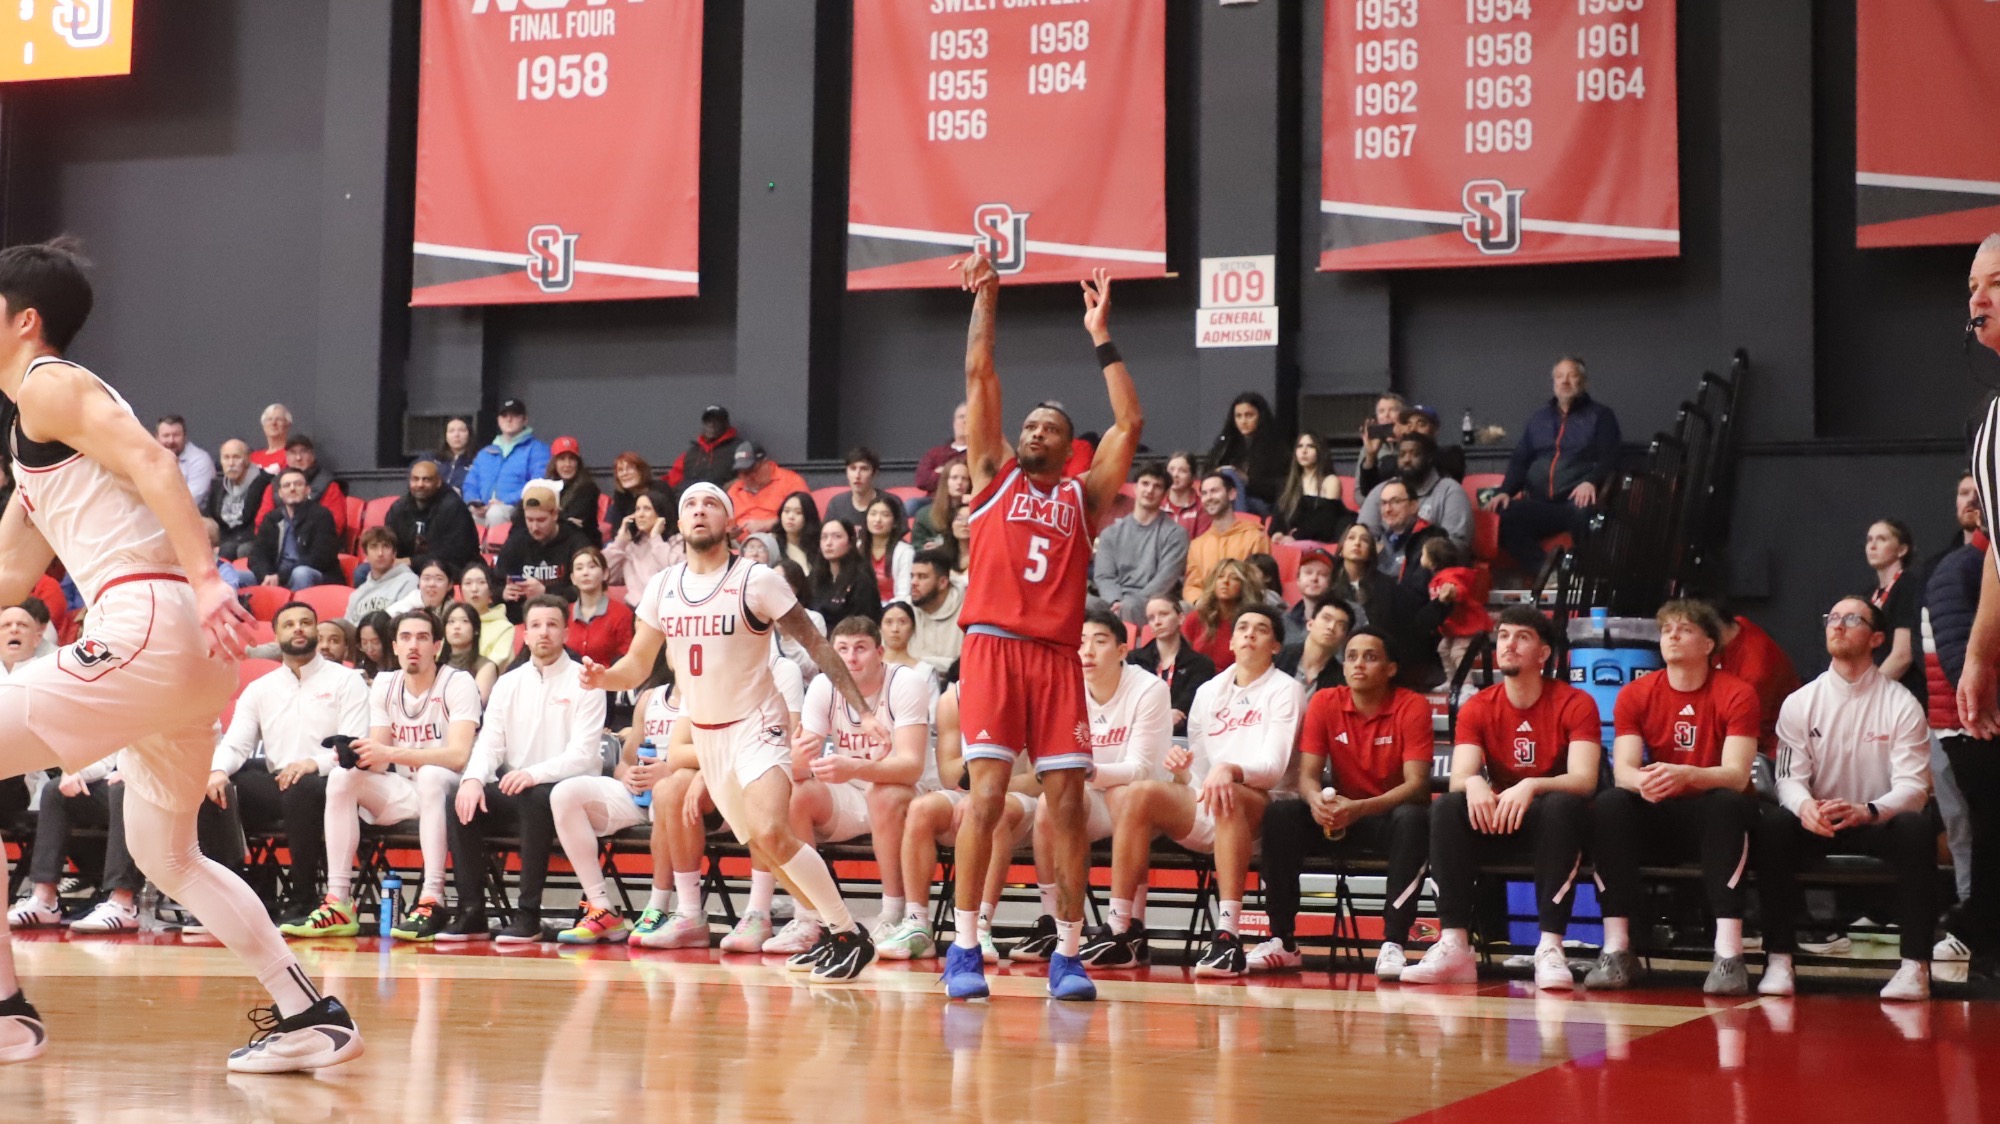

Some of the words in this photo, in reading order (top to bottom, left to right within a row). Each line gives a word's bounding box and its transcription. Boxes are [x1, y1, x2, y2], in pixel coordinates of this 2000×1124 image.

[510, 13, 562, 42] FINAL
[566, 9, 615, 38] FOUR
[1356, 0, 1418, 31] 1953
[930, 28, 988, 61] 1953
[1030, 20, 1089, 54] 1958
[1466, 32, 1532, 68] 1958
[1577, 23, 1639, 59] 1961
[1356, 38, 1418, 74] 1956
[517, 52, 608, 101] 1958
[929, 69, 988, 101] 1955
[1028, 60, 1087, 95] 1964
[1466, 74, 1532, 110] 1963
[1577, 66, 1646, 102] 1964
[1355, 80, 1418, 117] 1962
[928, 109, 988, 141] 1956
[1355, 124, 1417, 159] 1967
[1465, 118, 1533, 153] 1969
[1220, 261, 1256, 271] SECTION
[1212, 270, 1265, 303] 109
[1209, 311, 1265, 326] GENERAL
[1202, 329, 1273, 344] ADMISSION
[1006, 493, 1076, 537] LMU
[1023, 535, 1050, 584] 5
[660, 614, 735, 638] SEATTLEU
[689, 643, 703, 677] 0
